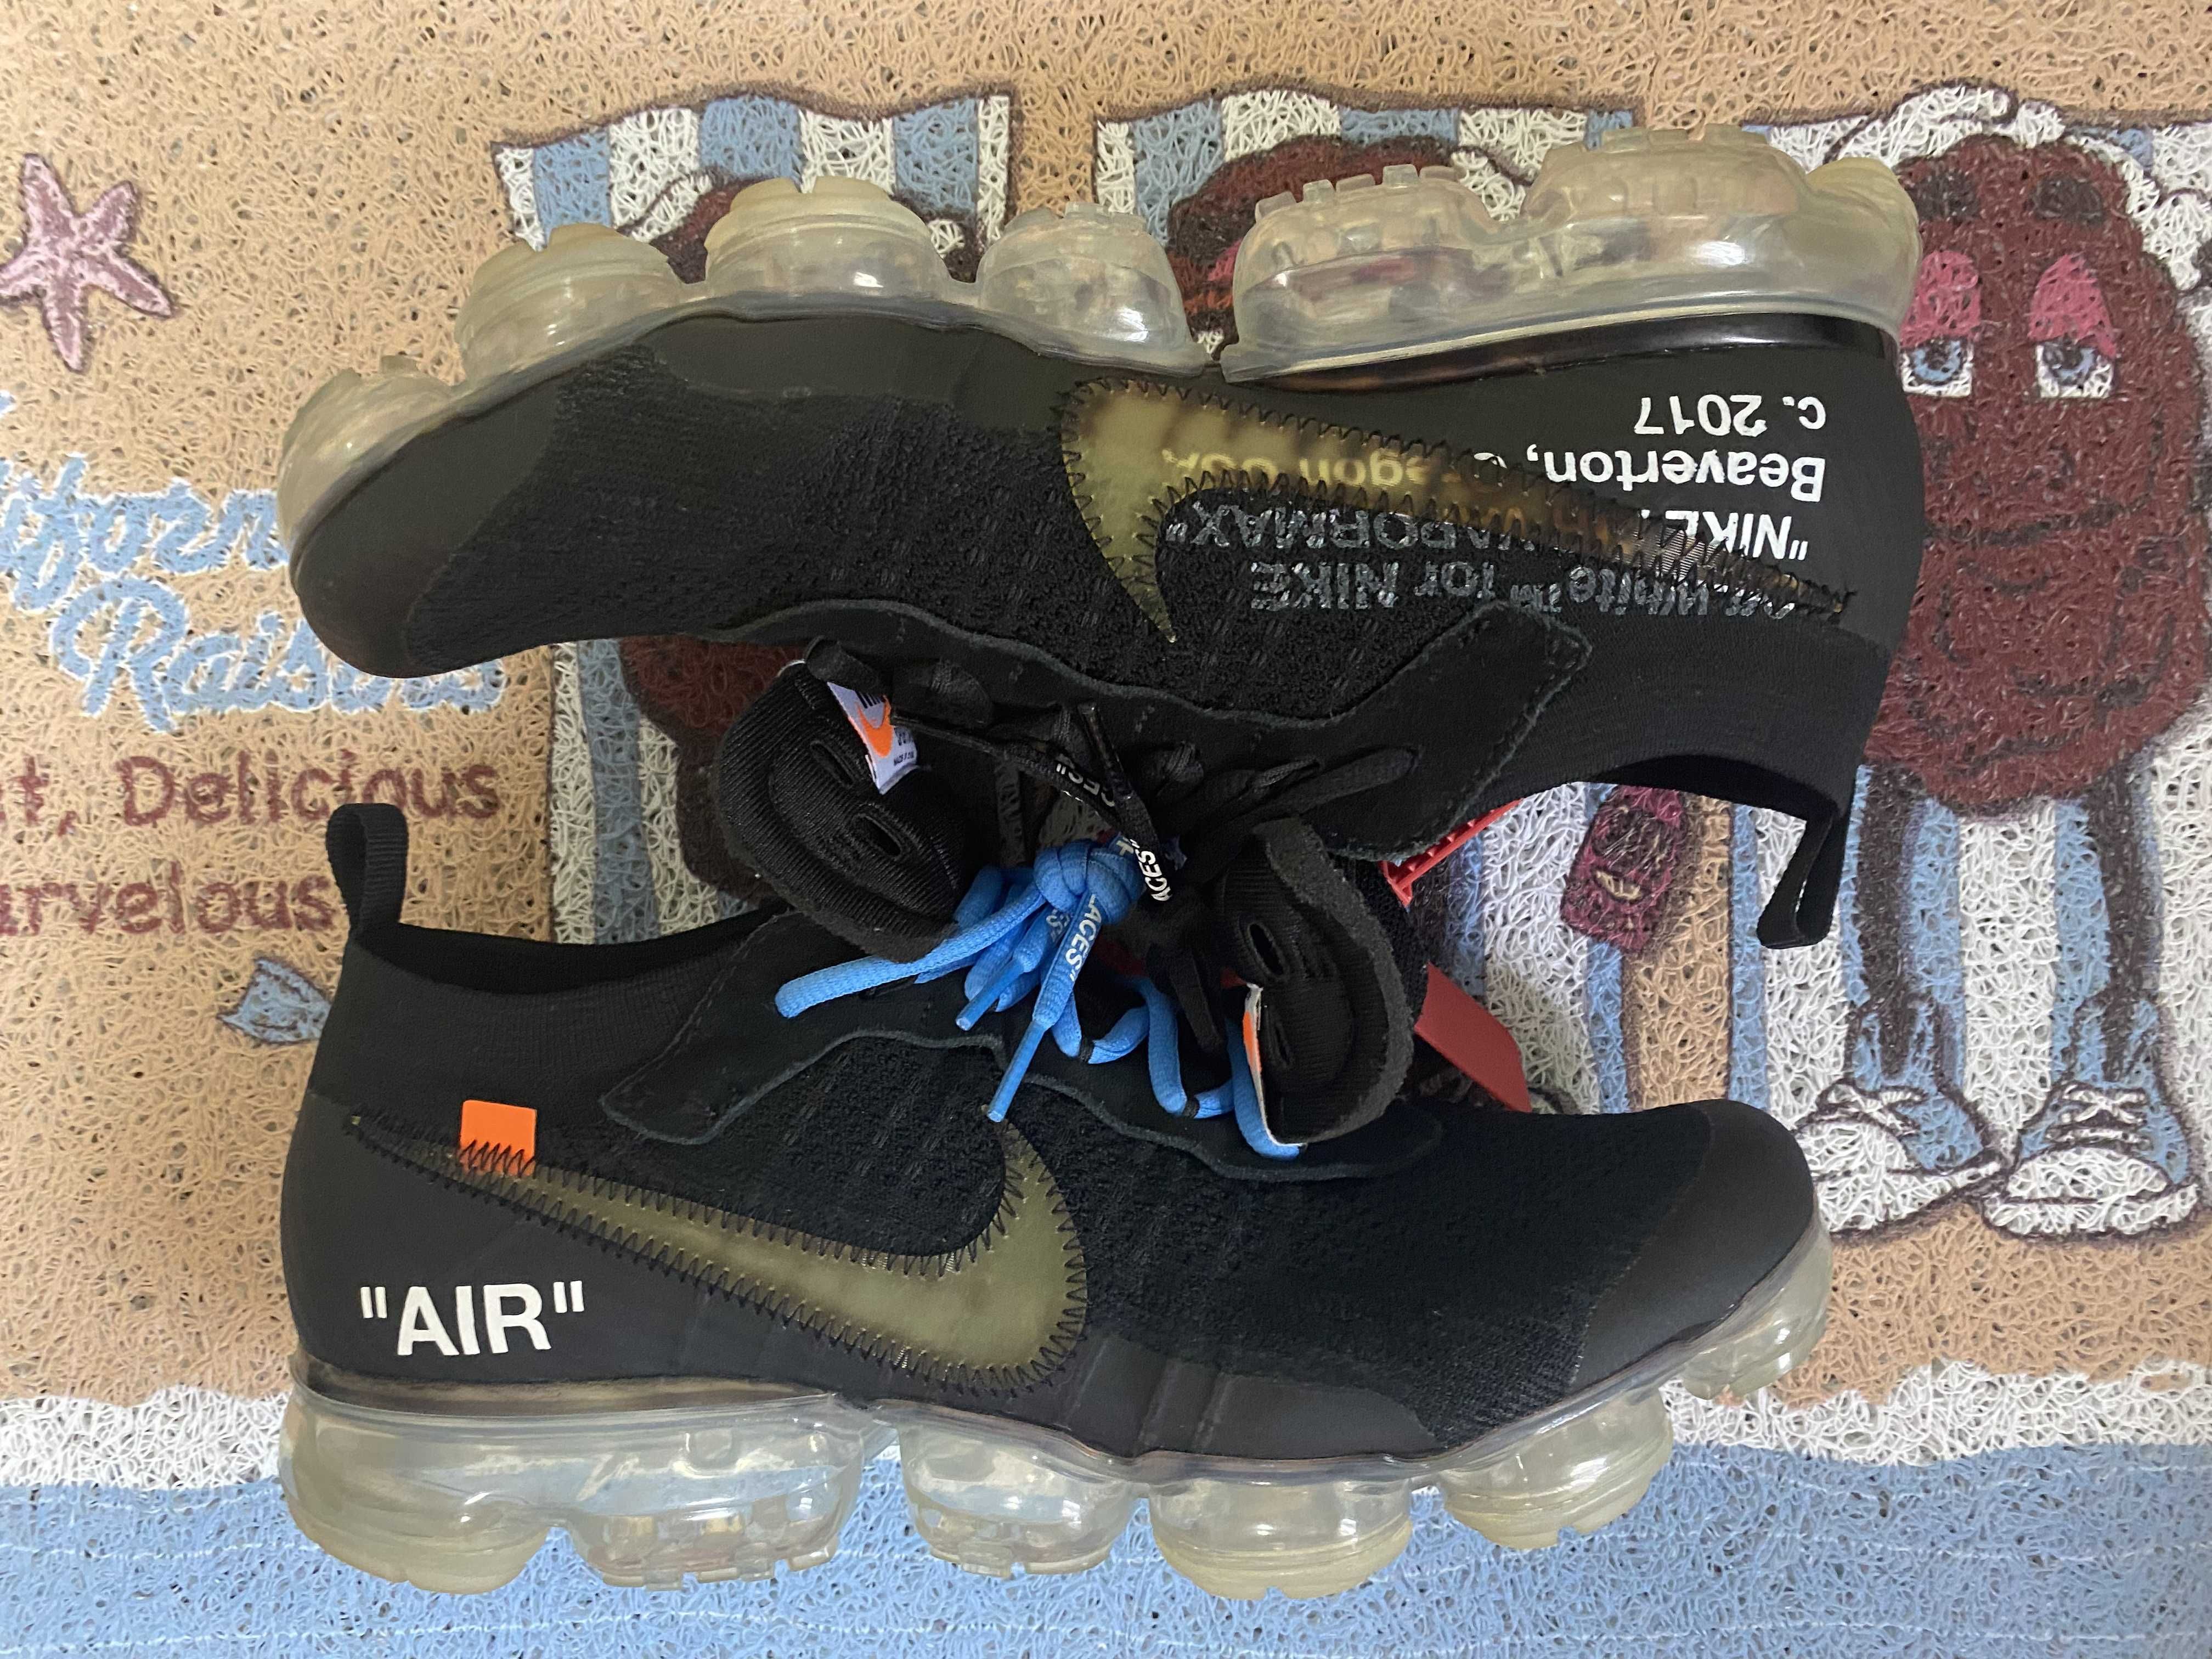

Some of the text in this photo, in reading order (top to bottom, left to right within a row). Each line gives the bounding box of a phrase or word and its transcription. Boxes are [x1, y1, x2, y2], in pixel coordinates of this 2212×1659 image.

[1634, 394, 1826, 437] c. 2017
[1527, 444, 1826, 503] Beaverton,
[1250, 561, 1399, 611] NIKE
[1414, 561, 1496, 601] for
[115, 748, 500, 826] Delicious
[360, 1280, 585, 1356] "AIR"
